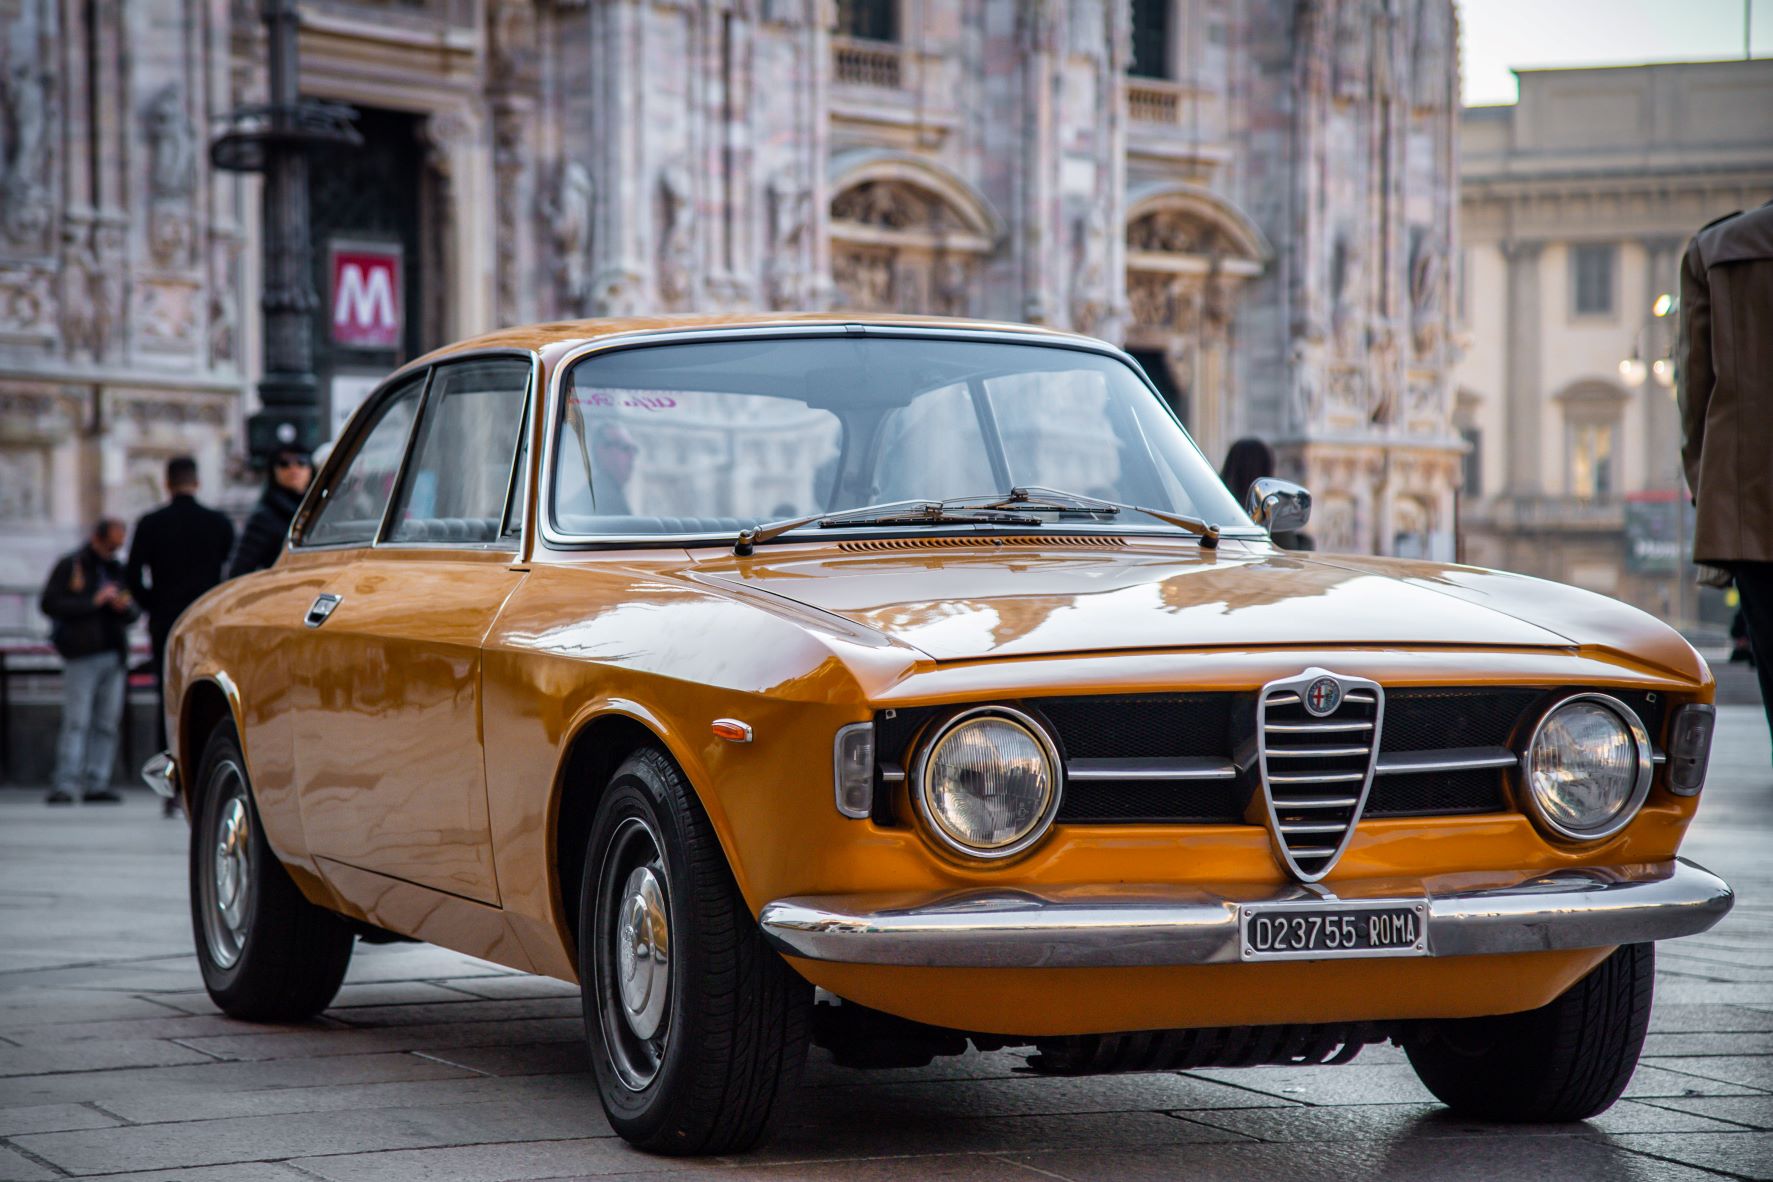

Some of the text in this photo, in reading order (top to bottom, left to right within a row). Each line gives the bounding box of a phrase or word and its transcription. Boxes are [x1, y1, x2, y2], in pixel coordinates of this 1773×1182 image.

[335, 264, 395, 328] M
[1257, 914, 1415, 949] D23755 ROMA
